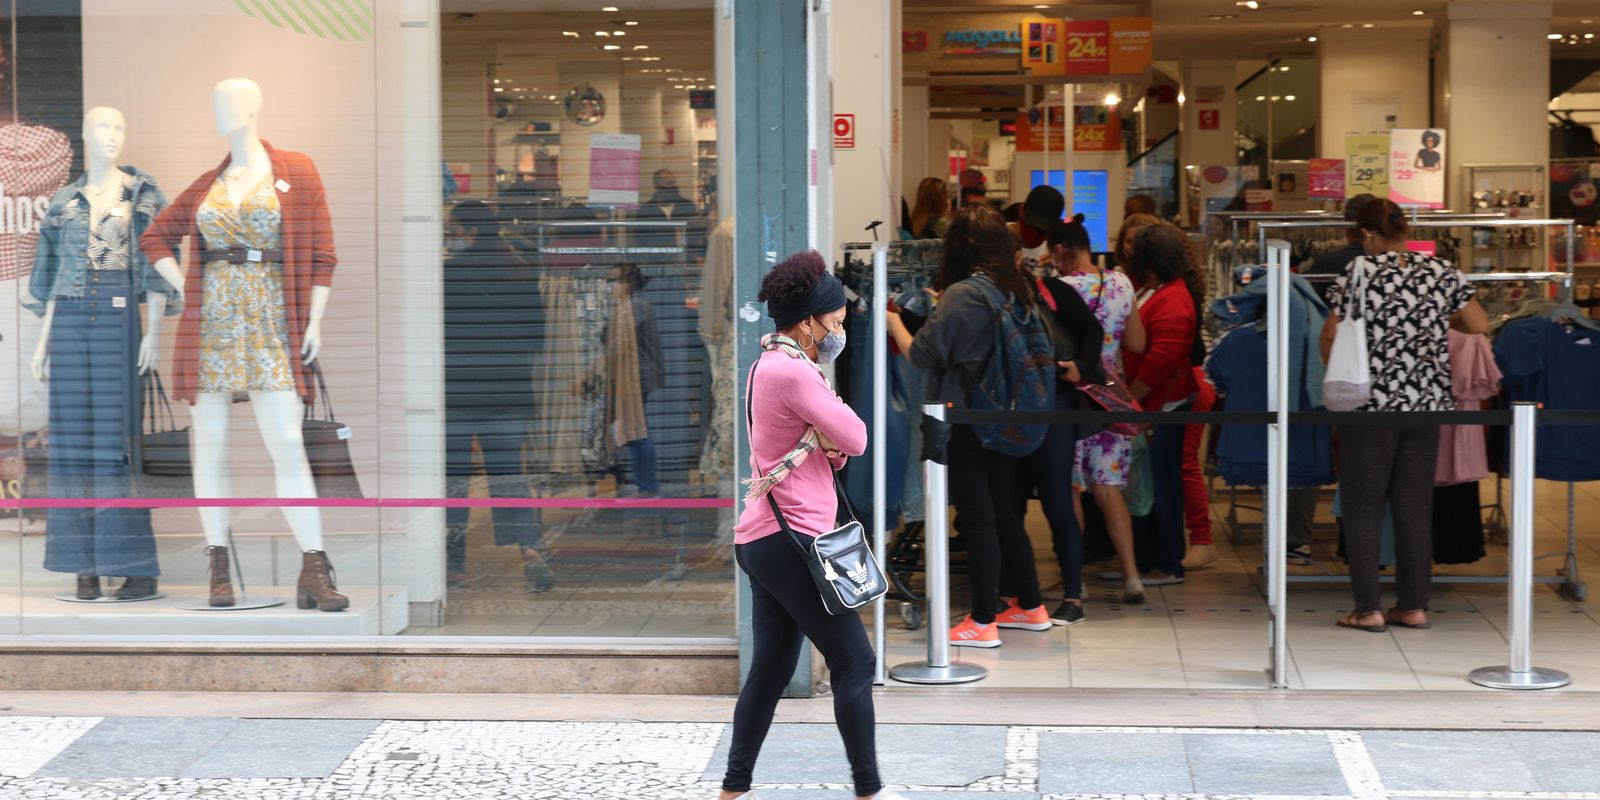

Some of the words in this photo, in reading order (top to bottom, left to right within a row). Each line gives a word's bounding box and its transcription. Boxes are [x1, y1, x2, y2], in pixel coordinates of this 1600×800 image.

[1068, 37, 1107, 57] 24x
[1075, 128, 1106, 141] 24x
[854, 580, 877, 595] adidas
